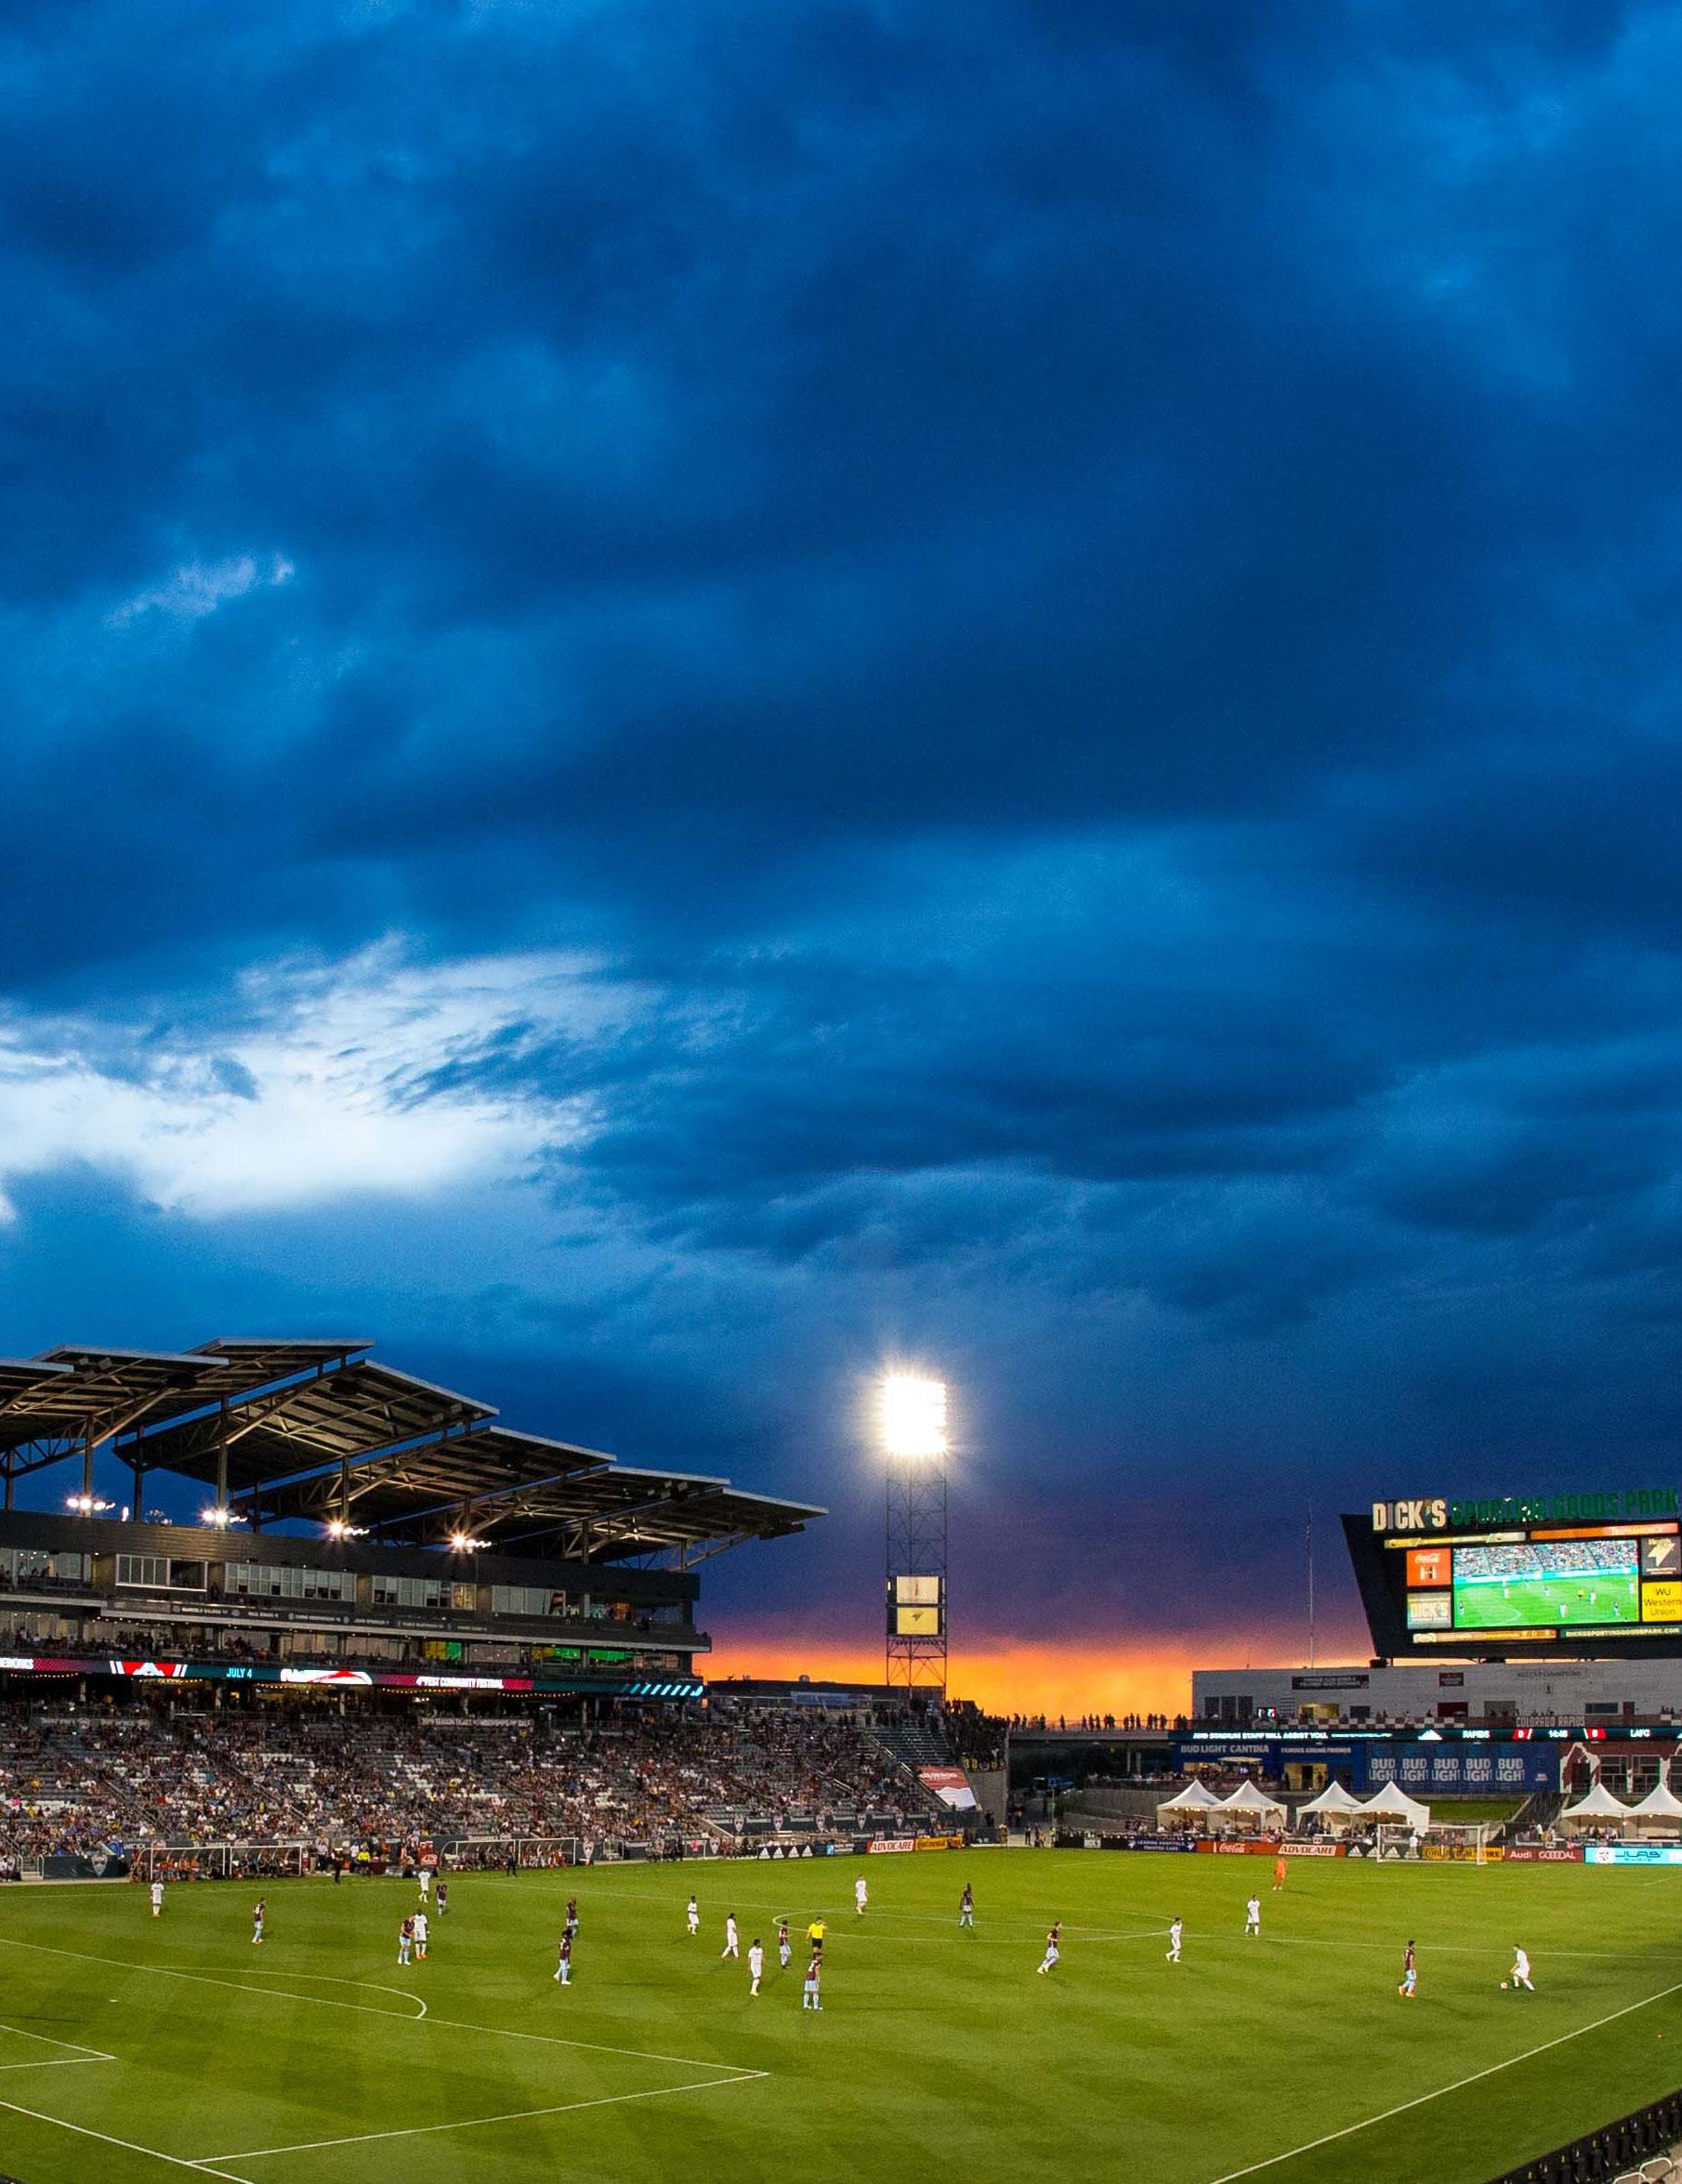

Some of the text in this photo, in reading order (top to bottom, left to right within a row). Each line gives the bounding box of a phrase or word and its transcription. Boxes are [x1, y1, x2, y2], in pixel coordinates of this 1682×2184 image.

[1373, 1499, 1447, 1531] DICK'S
[1623, 1488, 1679, 1515] PARK
[1655, 1587, 1671, 1596] WU
[1644, 1598, 1682, 1607] Western
[1650, 1608, 1676, 1616] Union
[226, 1667, 253, 1678] JULY 4
[1516, 1716, 1586, 1728] COLORADO RAPIDS
[1463, 1730, 1490, 1739] RAPIDS
[1630, 1729, 1650, 1738] LAFC
[1180, 1744, 1269, 1754] BUD LIGHT CANTINA
[1371, 1758, 1396, 1770] BUD
[1402, 1758, 1427, 1770] BUD
[1434, 1758, 1459, 1770] BUD
[1465, 1758, 1491, 1770] BUD
[1498, 1758, 1524, 1770] BUD
[1368, 1770, 1398, 1782] LIGHT
[1399, 1770, 1428, 1782] LIGHT
[1431, 1770, 1461, 1782] LIGHT
[1463, 1770, 1492, 1782] LIGHT
[1494, 1770, 1525, 1782] LIGHT
[873, 1841, 912, 1852] ADVOCARE
[1280, 1844, 1336, 1855] ADVOCARE
[1509, 1850, 1532, 1859] Audi
